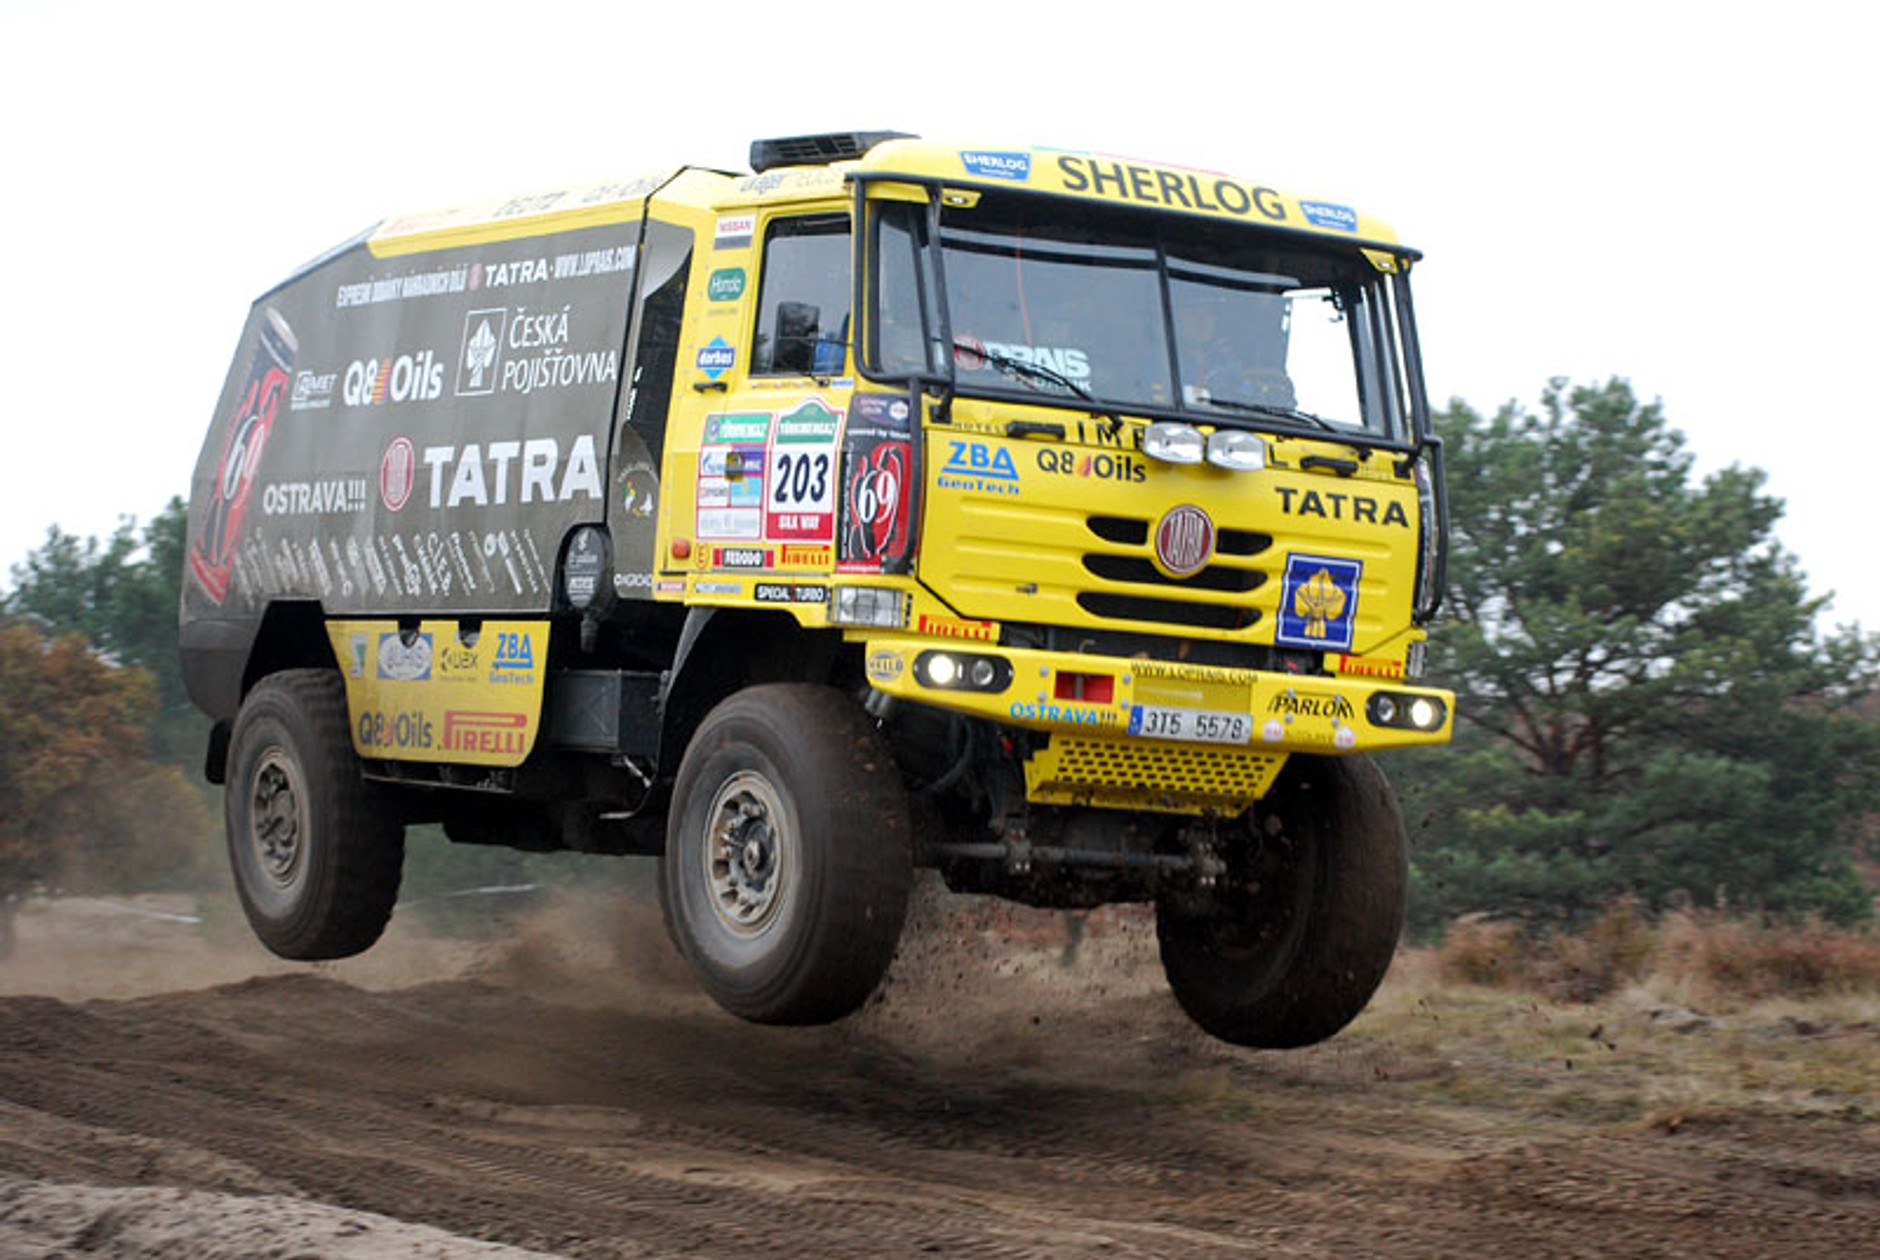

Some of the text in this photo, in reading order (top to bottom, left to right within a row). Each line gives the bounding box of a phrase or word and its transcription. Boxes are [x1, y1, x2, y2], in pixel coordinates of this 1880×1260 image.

[1057, 155, 1286, 220] SHERLOG
[485, 258, 548, 288] TATRA
[509, 305, 572, 349] ČESKÁ
[501, 347, 618, 395] POJIŠŤOVNA
[423, 434, 604, 510] TATRA
[945, 441, 1018, 477] ZBA
[774, 453, 831, 504] 203
[938, 477, 1020, 496] GeoTech
[263, 480, 366, 516] OSTRAVA!!!
[1274, 486, 1409, 527] TATRA
[780, 544, 829, 566] PIRELLI
[795, 586, 823, 602] TURBO
[918, 614, 992, 641] PIRELLI
[494, 633, 533, 666] ZBA
[443, 710, 528, 754] PIRELLI
[1144, 711, 1181, 735] 3T5
[1194, 714, 1242, 740] 5578
